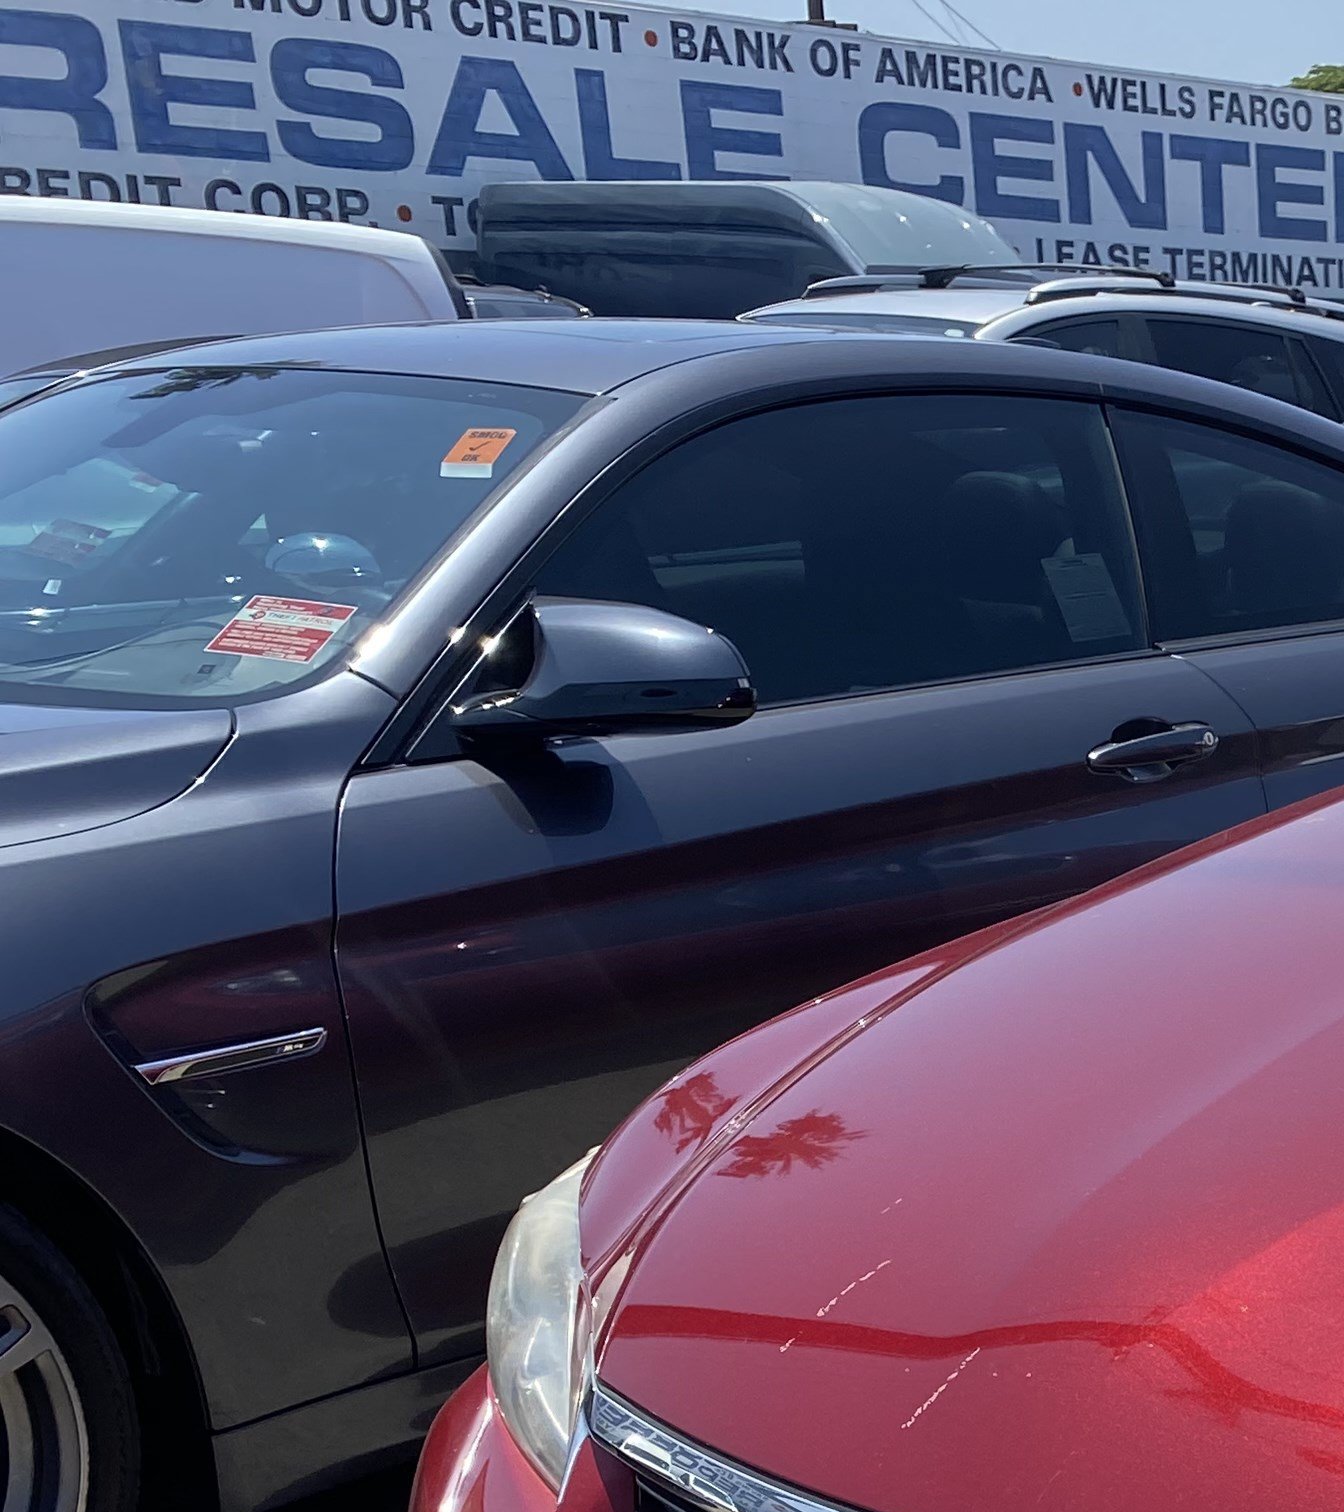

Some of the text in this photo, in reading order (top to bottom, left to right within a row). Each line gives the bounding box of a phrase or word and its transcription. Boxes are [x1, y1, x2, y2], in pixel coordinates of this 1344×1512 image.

[0, 8, 793, 182] RESALE
[450, 0, 629, 54] CREDIT
[670, 20, 795, 73] BANK
[810, 39, 862, 80] OF
[875, 46, 1053, 103] AMERICA
[1086, 74, 1196, 119] WELLS
[1209, 89, 1312, 132] FARGO
[1035, 237, 1151, 275] LEASE
